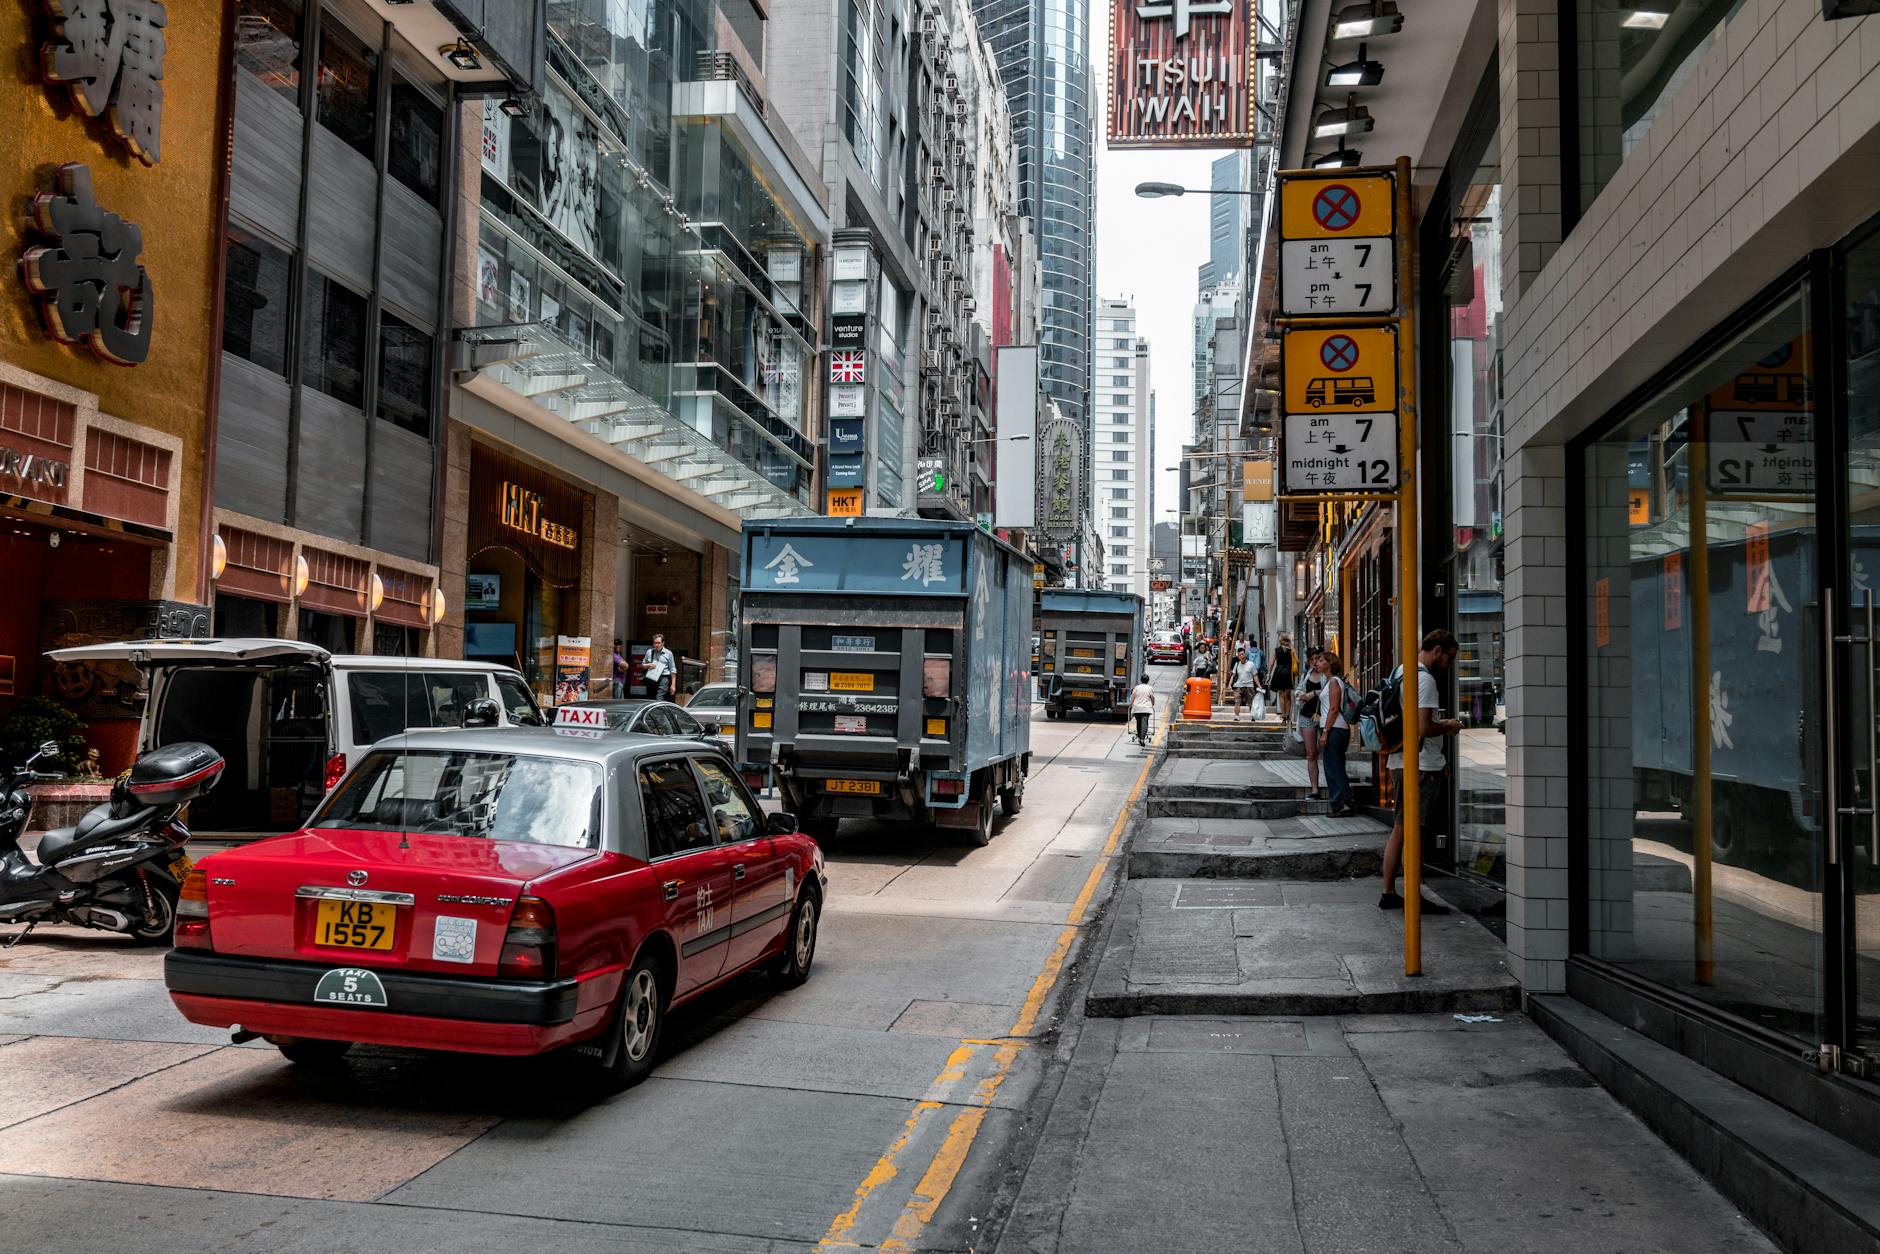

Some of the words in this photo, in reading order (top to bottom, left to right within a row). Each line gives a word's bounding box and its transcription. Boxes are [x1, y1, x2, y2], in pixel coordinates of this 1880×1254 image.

[1139, 57, 1226, 85] TSUI
[1138, 95, 1226, 123] WAH
[1310, 243, 1329, 253] am
[1305, 256, 1336, 270] 上午
[1354, 245, 1372, 268] 7
[1310, 282, 1330, 294] pm
[1305, 296, 1336, 309] 下午
[1354, 284, 1372, 307] 7
[834, 325, 864, 333] venture
[1310, 417, 1329, 426] am
[1305, 430, 1336, 444] 上午
[1355, 419, 1373, 443] 7
[1291, 457, 1349, 469] midnight
[1305, 472, 1337, 485] 午夜
[1357, 460, 1390, 484] 12
[832, 496, 857, 507] HKT
[764, 543, 815, 585] 金
[900, 543, 947, 588] 耀
[854, 704, 899, 713] 23642387
[560, 708, 600, 724] TAXI
[831, 780, 847, 790] JT
[849, 781, 876, 791] 2381
[174, 859, 186, 870] SF
[340, 903, 373, 924] KB
[696, 911, 714, 935] TAXI
[324, 922, 385, 948] 1557
[338, 970, 368, 978] TAXI
[344, 977, 358, 992] 5
[329, 992, 372, 1002] SEATS
